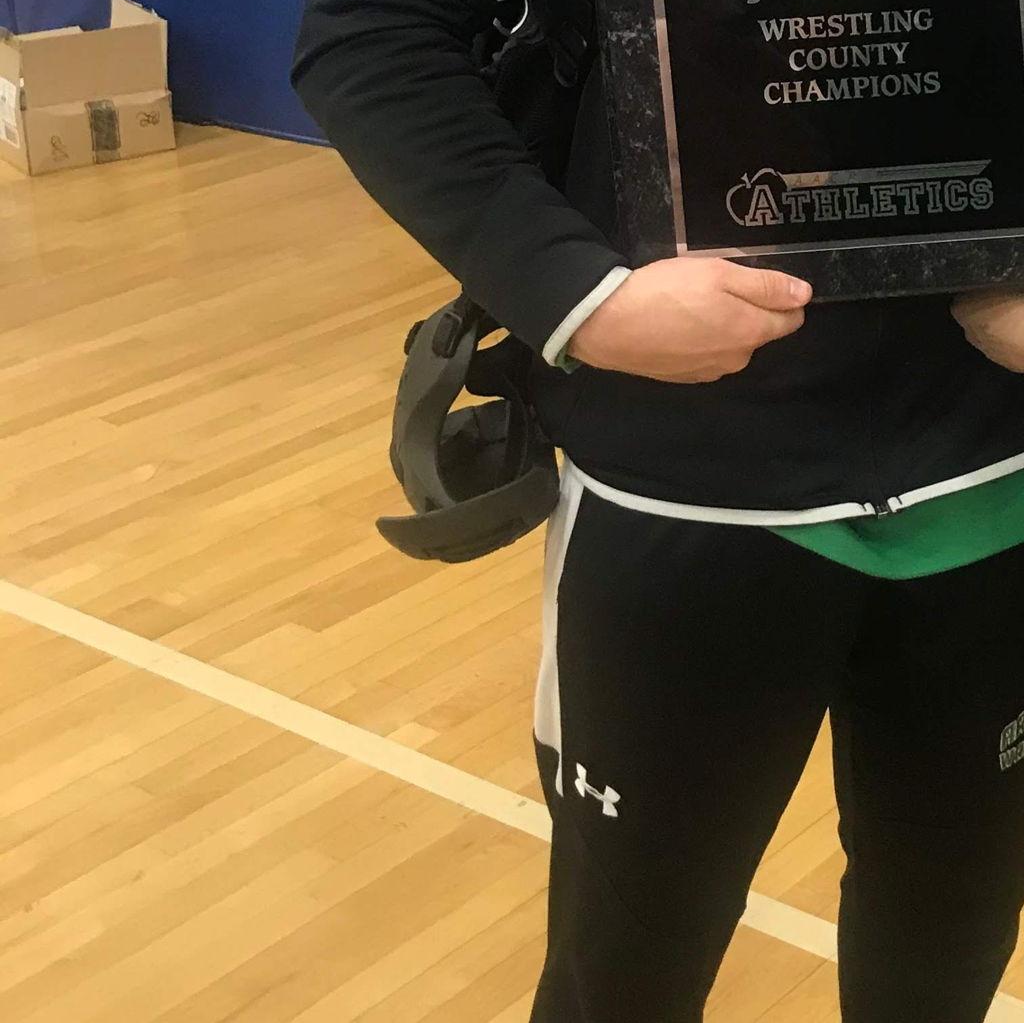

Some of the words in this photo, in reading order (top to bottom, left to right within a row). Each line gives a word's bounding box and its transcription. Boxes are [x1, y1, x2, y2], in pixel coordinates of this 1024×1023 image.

[758, 8, 933, 43] WRESTLING
[788, 41, 909, 72] COUNTY
[763, 71, 941, 105] CHAMPIONS
[744, 177, 995, 227] ATHLETICS
